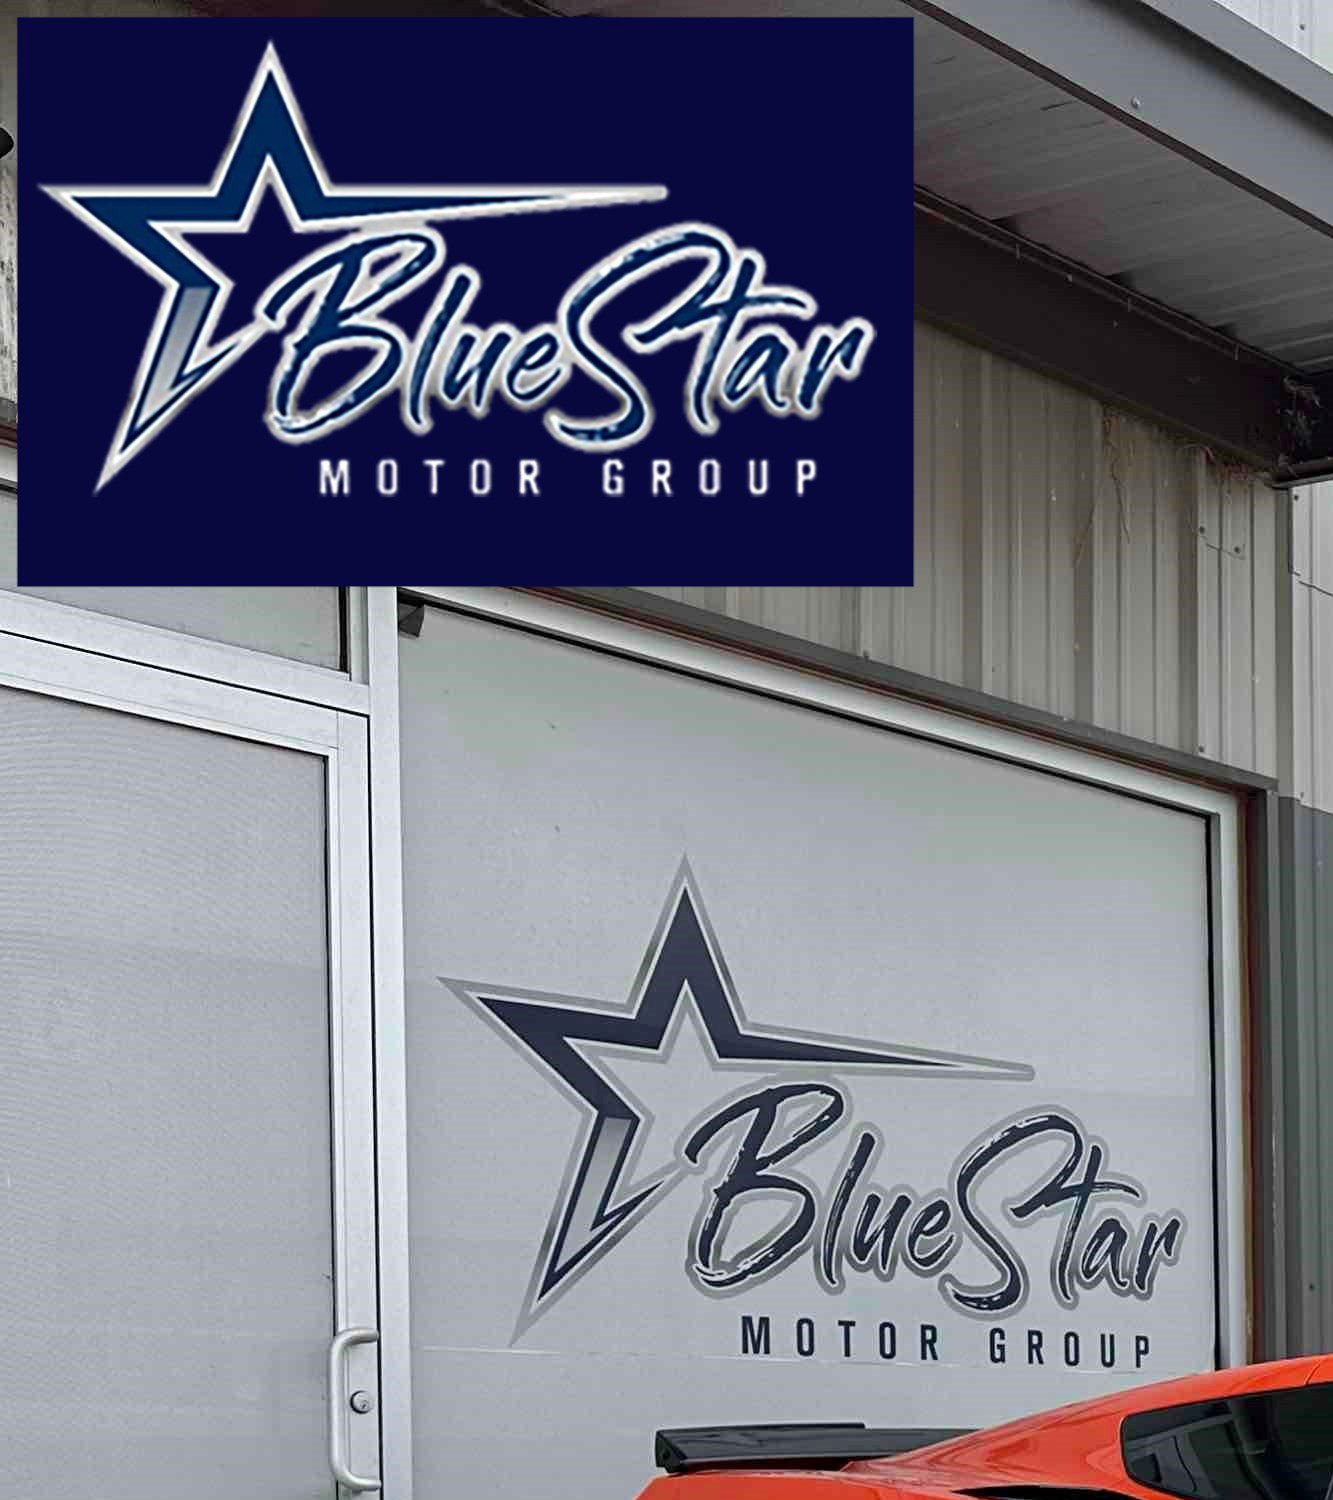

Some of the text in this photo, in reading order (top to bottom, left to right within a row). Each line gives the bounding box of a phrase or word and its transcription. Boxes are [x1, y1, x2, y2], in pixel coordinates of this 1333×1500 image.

[682, 1078, 1183, 1314] BlueStar
[741, 1315, 1151, 1369] MOTOR GROUP
